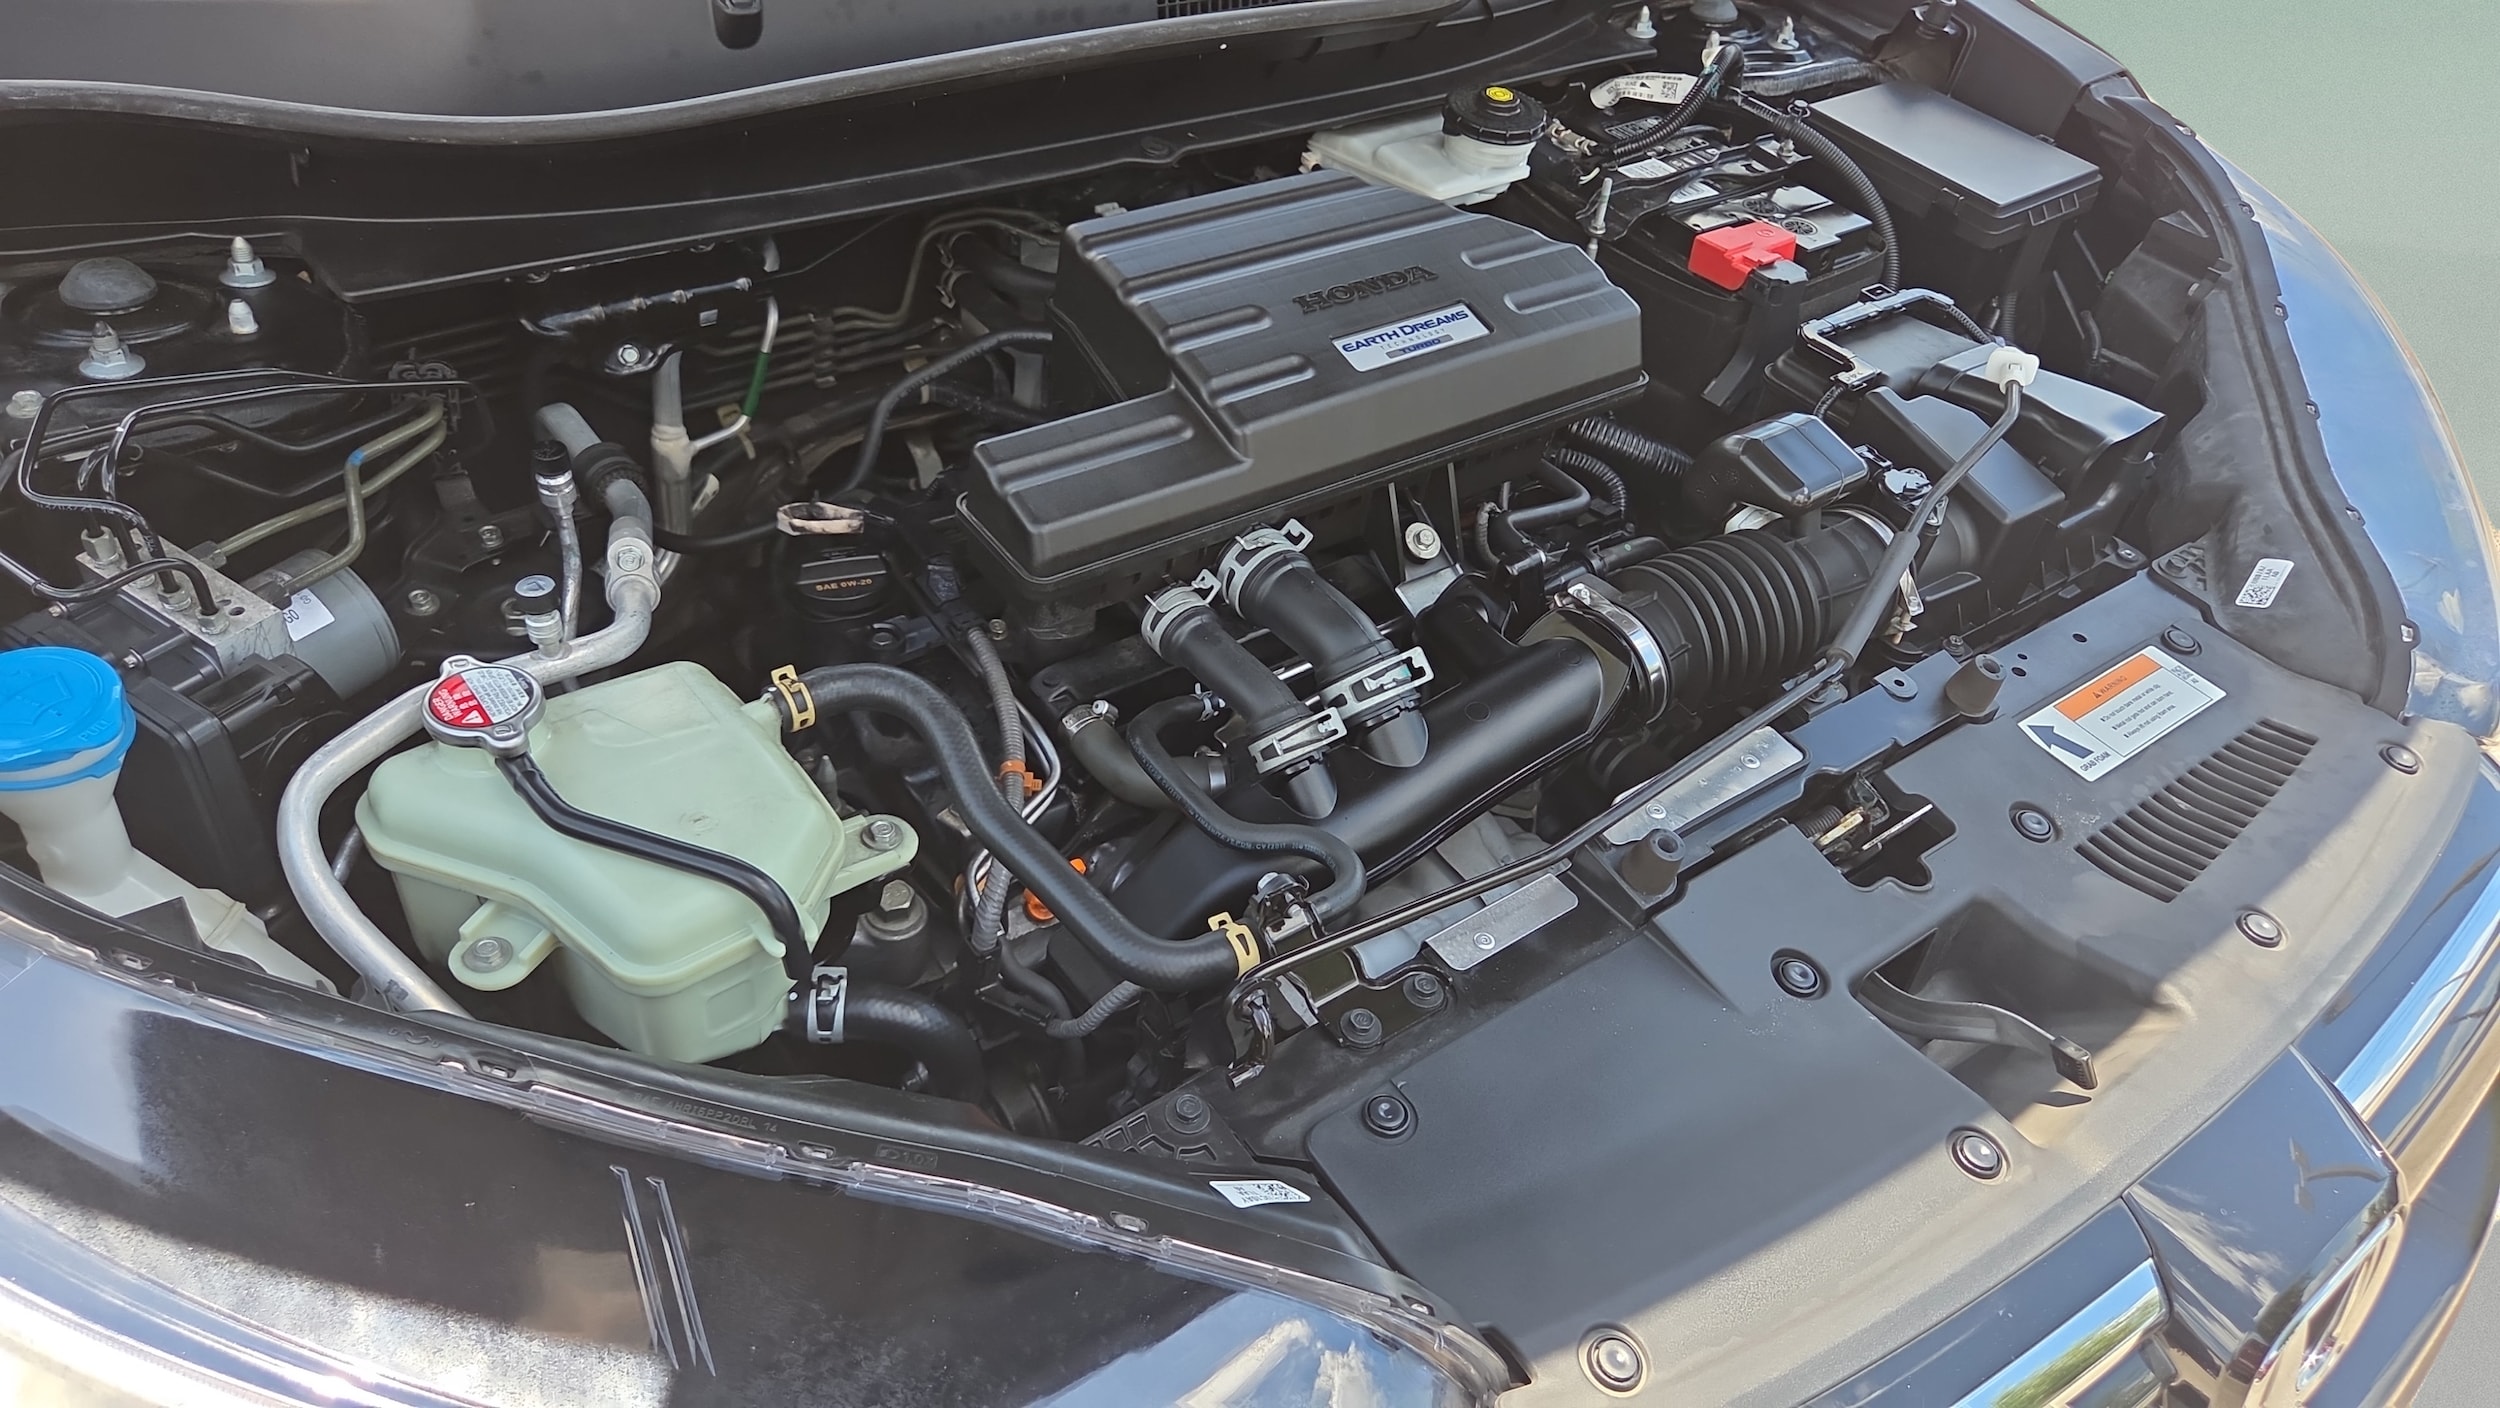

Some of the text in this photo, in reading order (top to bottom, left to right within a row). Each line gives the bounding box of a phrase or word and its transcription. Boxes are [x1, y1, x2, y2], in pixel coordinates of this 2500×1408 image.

[1292, 265, 1439, 313] HONDA
[1342, 310, 1468, 353] EARTH DREAMS
[1380, 329, 1446, 350] TECHNOLOGY
[1399, 339, 1442, 354] TURBO
[815, 578, 872, 592] SAE 0W-20
[2101, 675, 2128, 694] WARNING
[78, 718, 113, 742] PULL
[2080, 751, 2111, 772] GRAB FOAM
